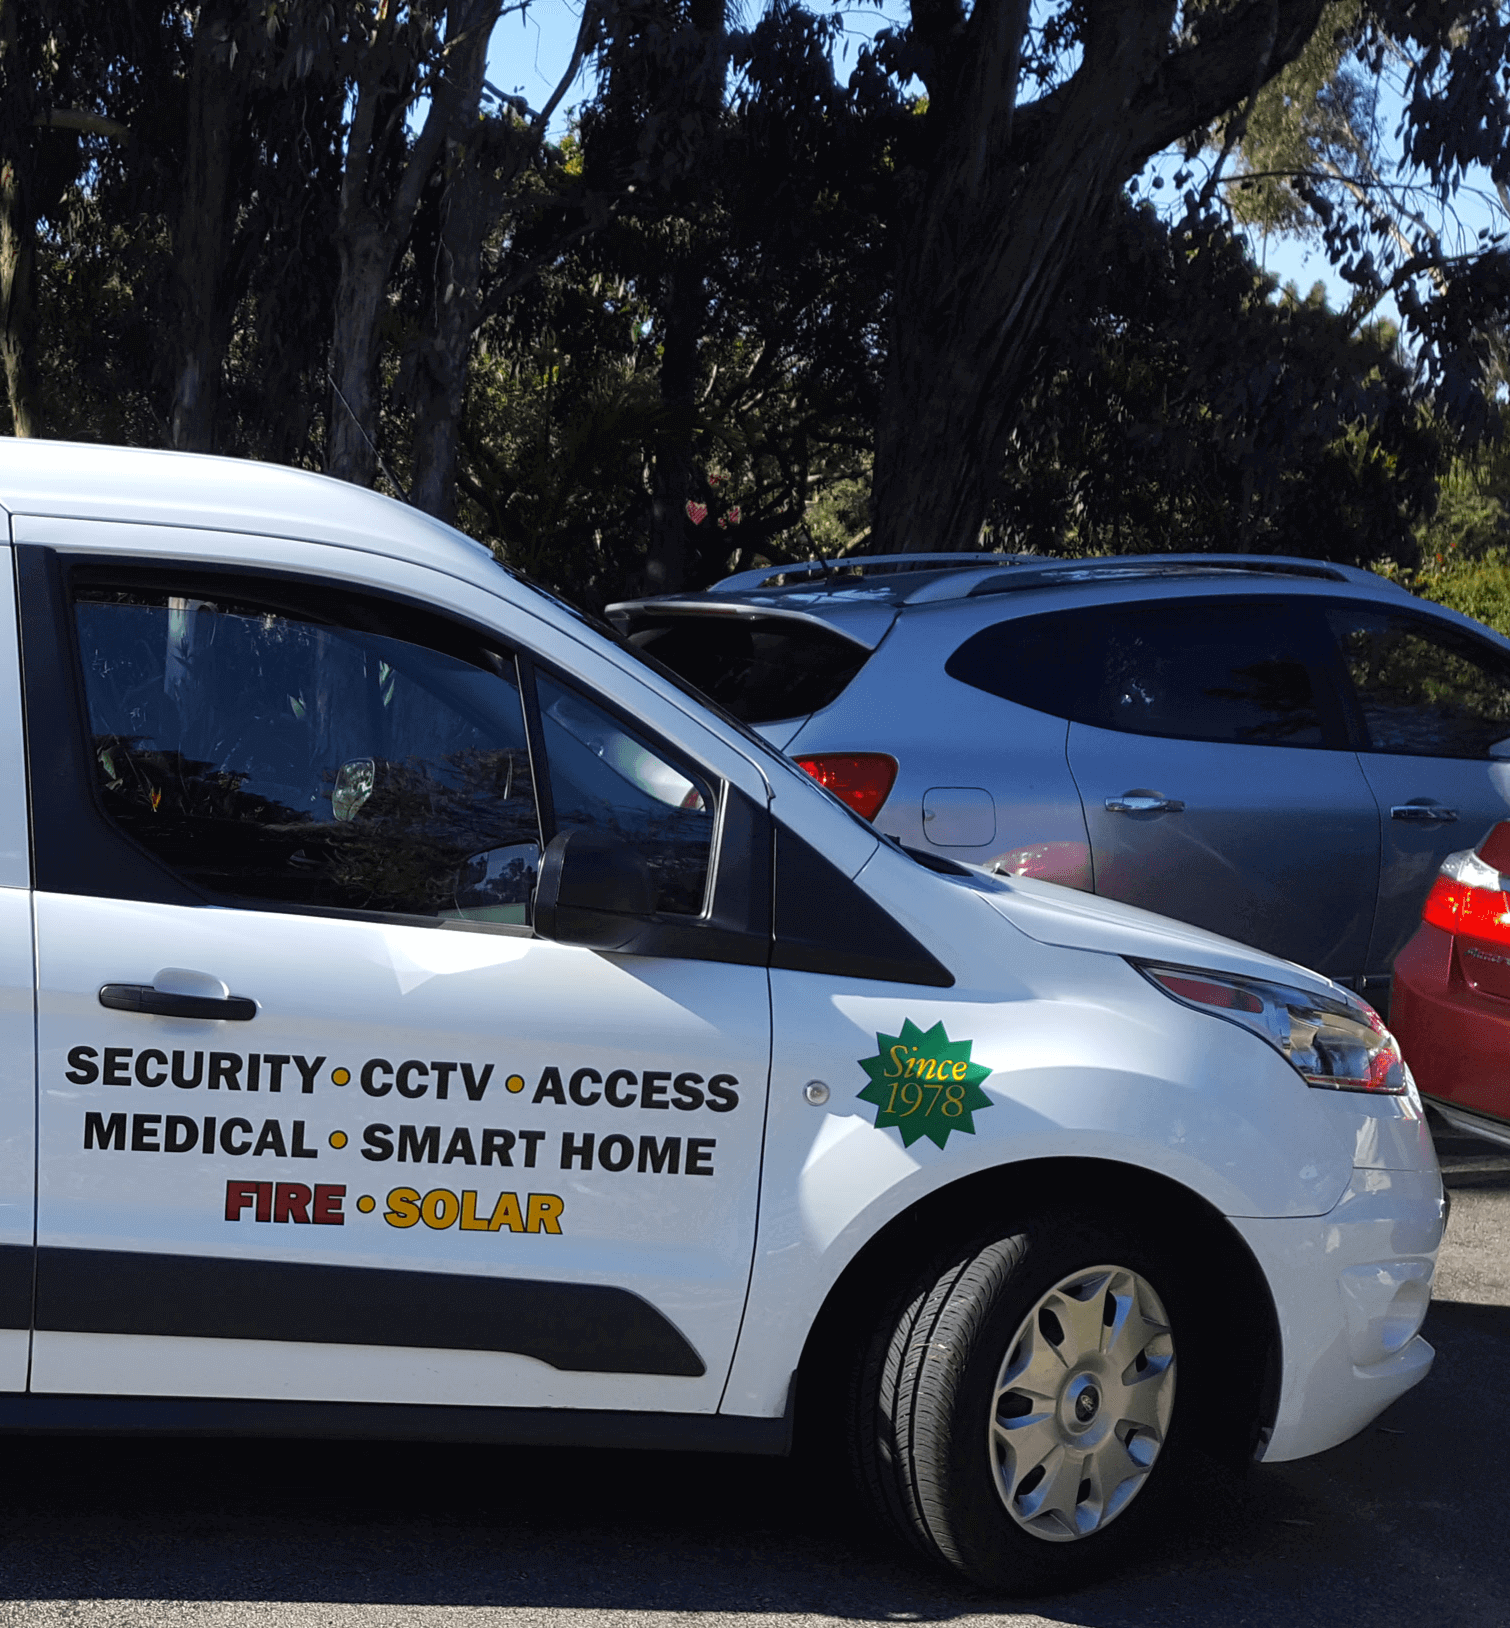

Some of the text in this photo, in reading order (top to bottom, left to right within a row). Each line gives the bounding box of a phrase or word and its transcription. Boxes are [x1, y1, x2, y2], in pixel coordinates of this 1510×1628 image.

[64, 1045, 740, 1113] SECURITY CCTV ACCESS
[883, 1045, 969, 1081] Since
[882, 1082, 967, 1117] 1978
[83, 1111, 718, 1177] MEDICAL SMART HOME
[224, 1179, 565, 1236] FIRE SOLAR
